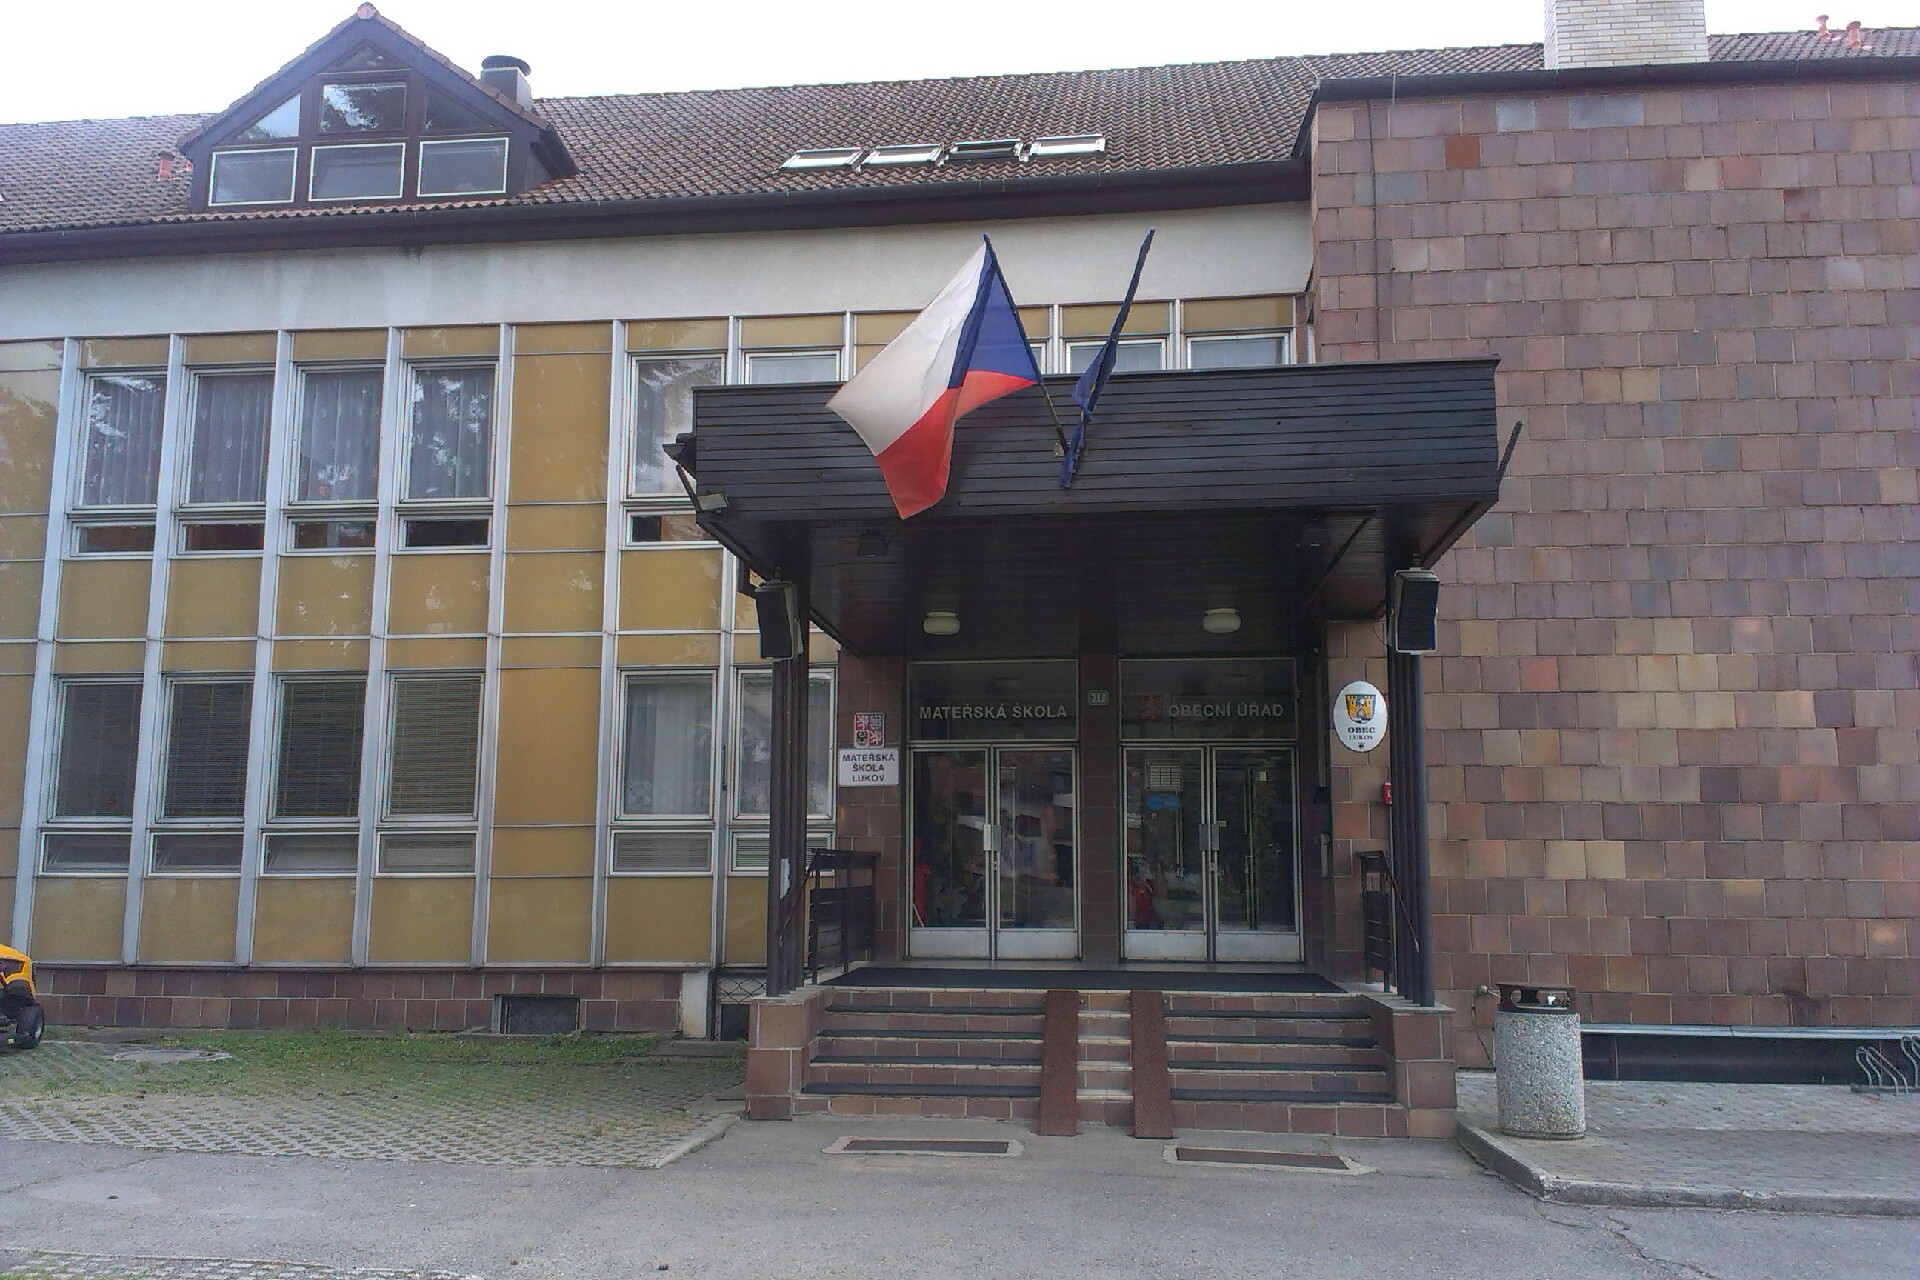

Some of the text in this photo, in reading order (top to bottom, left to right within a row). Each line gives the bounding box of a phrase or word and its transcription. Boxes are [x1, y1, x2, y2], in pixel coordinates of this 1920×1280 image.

[919, 702, 1068, 719] MATEŘSKÁ ŠKOLA
[1169, 701, 1285, 717] OBECNÍ ÚŘAD
[842, 752, 896, 762] MATEŘSKÁ
[852, 763, 885, 772] ŠKOLA
[852, 774, 885, 782] LUKOV
